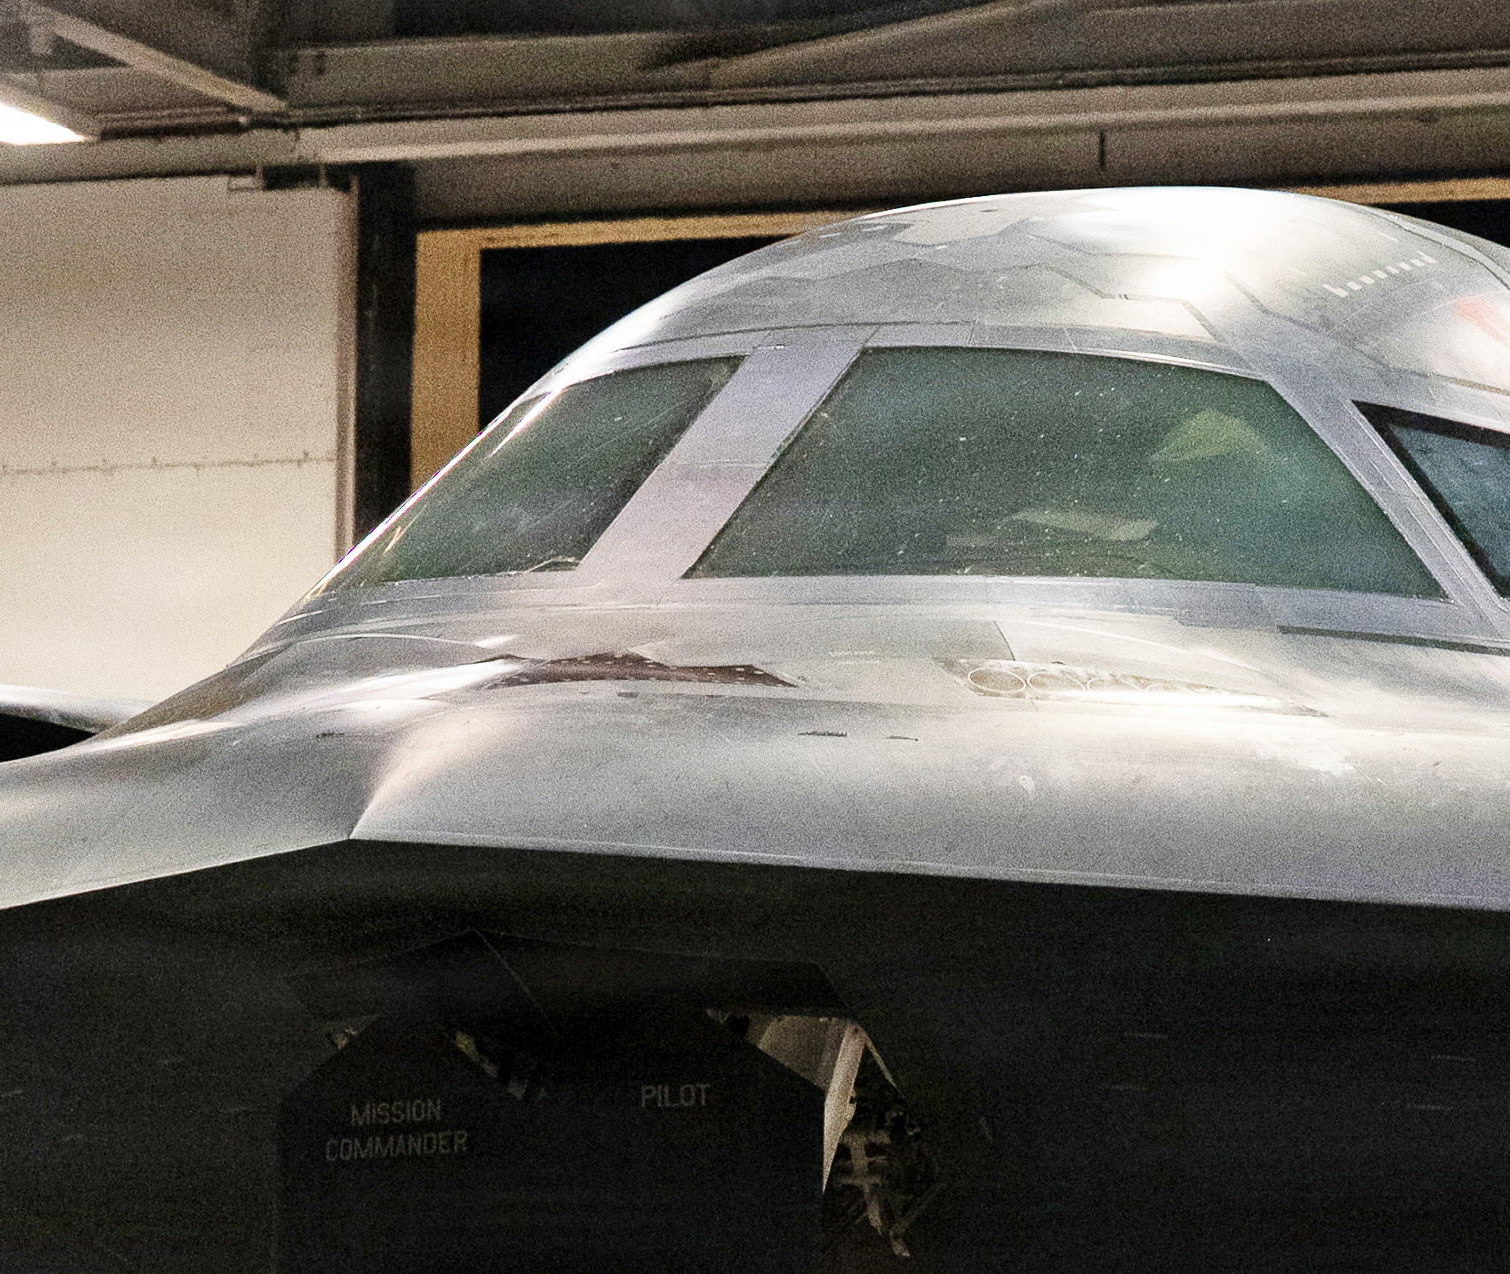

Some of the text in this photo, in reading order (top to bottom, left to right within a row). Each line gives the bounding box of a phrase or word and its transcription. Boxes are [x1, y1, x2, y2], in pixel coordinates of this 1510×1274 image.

[640, 1082, 712, 1109] PILOT
[350, 1099, 442, 1126] MISSION
[325, 1130, 469, 1162] COMMANDER
